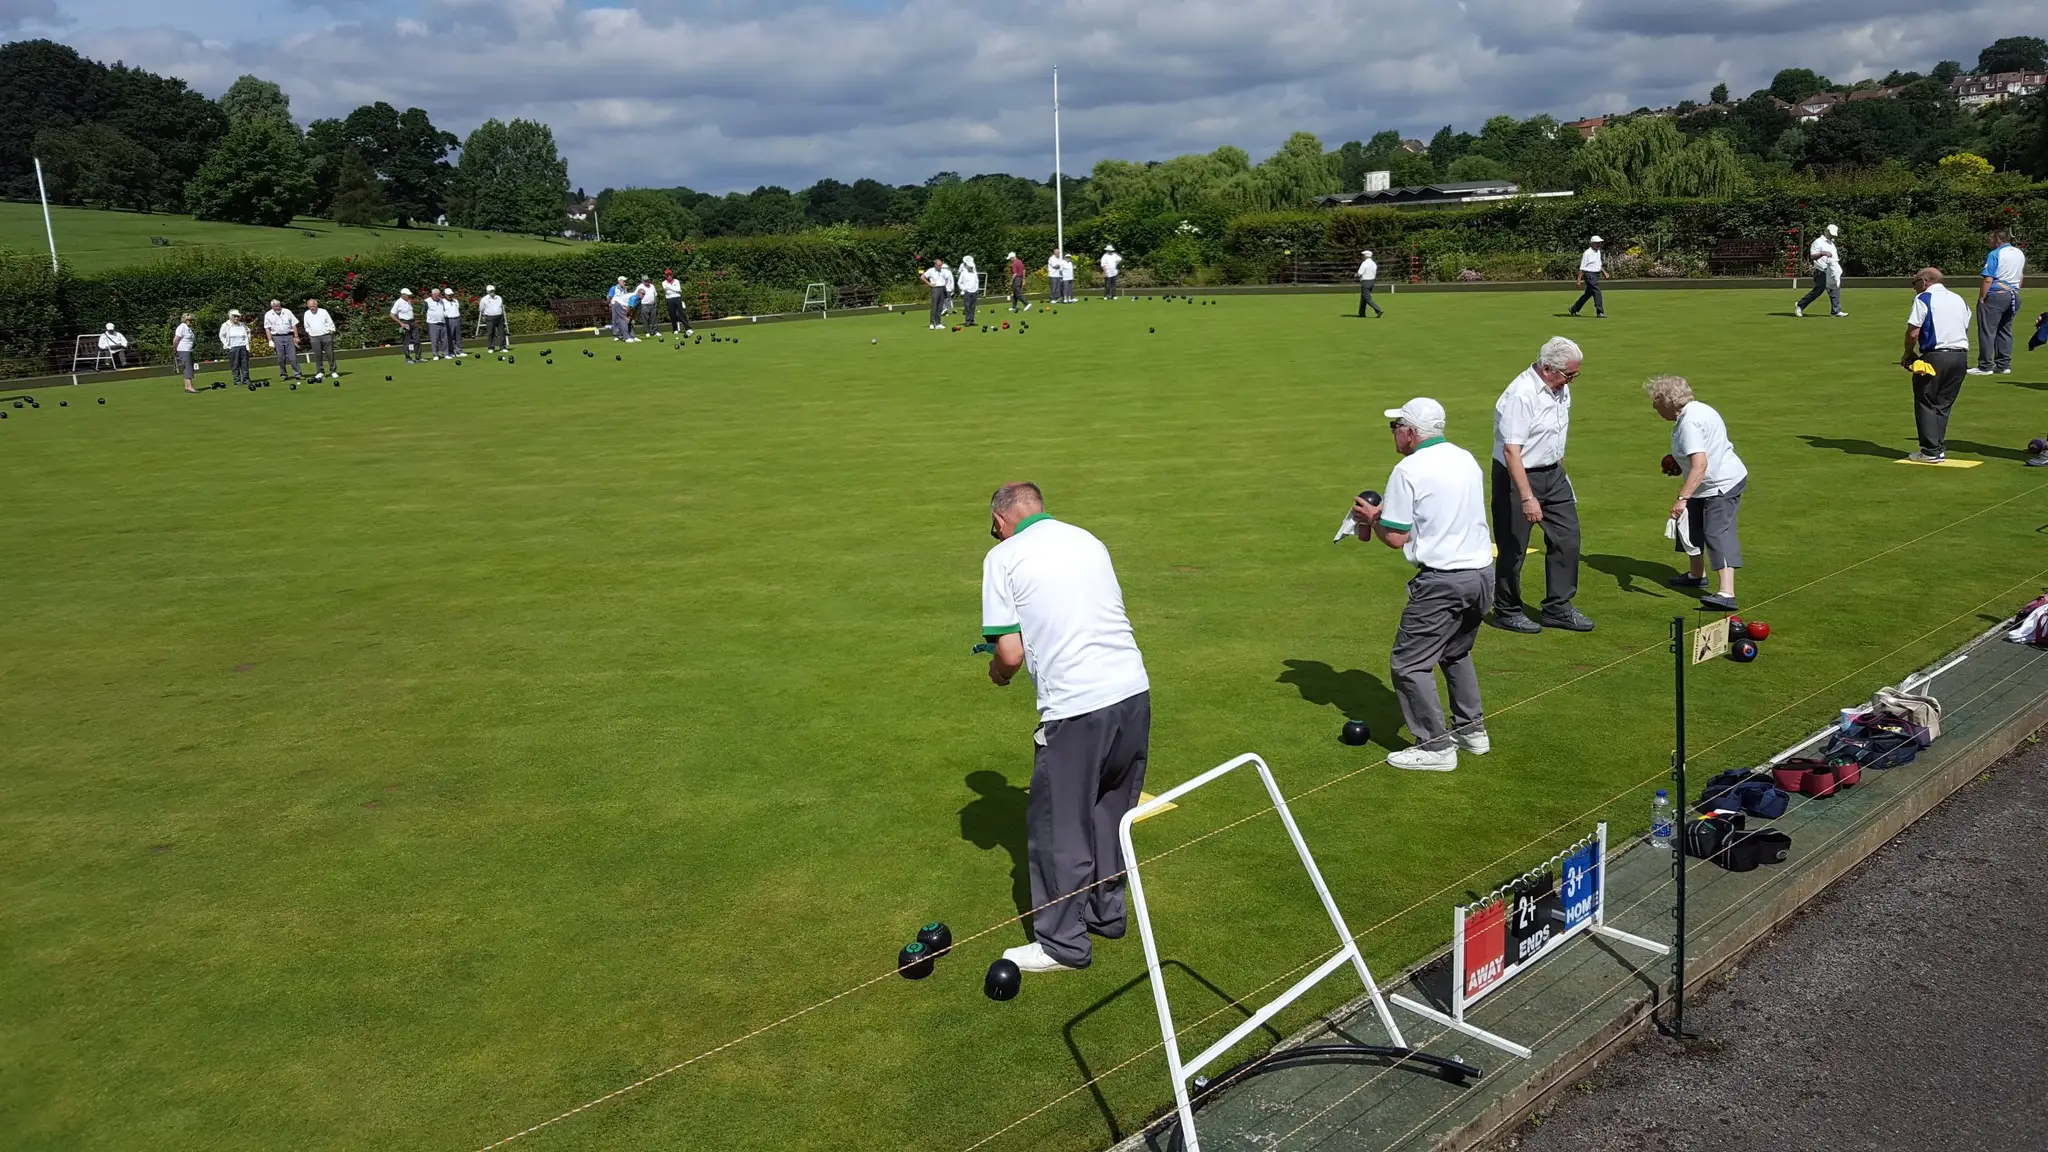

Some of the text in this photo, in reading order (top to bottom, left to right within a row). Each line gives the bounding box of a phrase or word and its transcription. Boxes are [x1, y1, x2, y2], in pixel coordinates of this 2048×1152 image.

[1567, 866, 1584, 898] 3+
[1519, 895, 1536, 929] 2+
[1566, 890, 1599, 924] HOME
[1519, 924, 1550, 959] ENDS
[1468, 955, 1504, 991] AWAY
